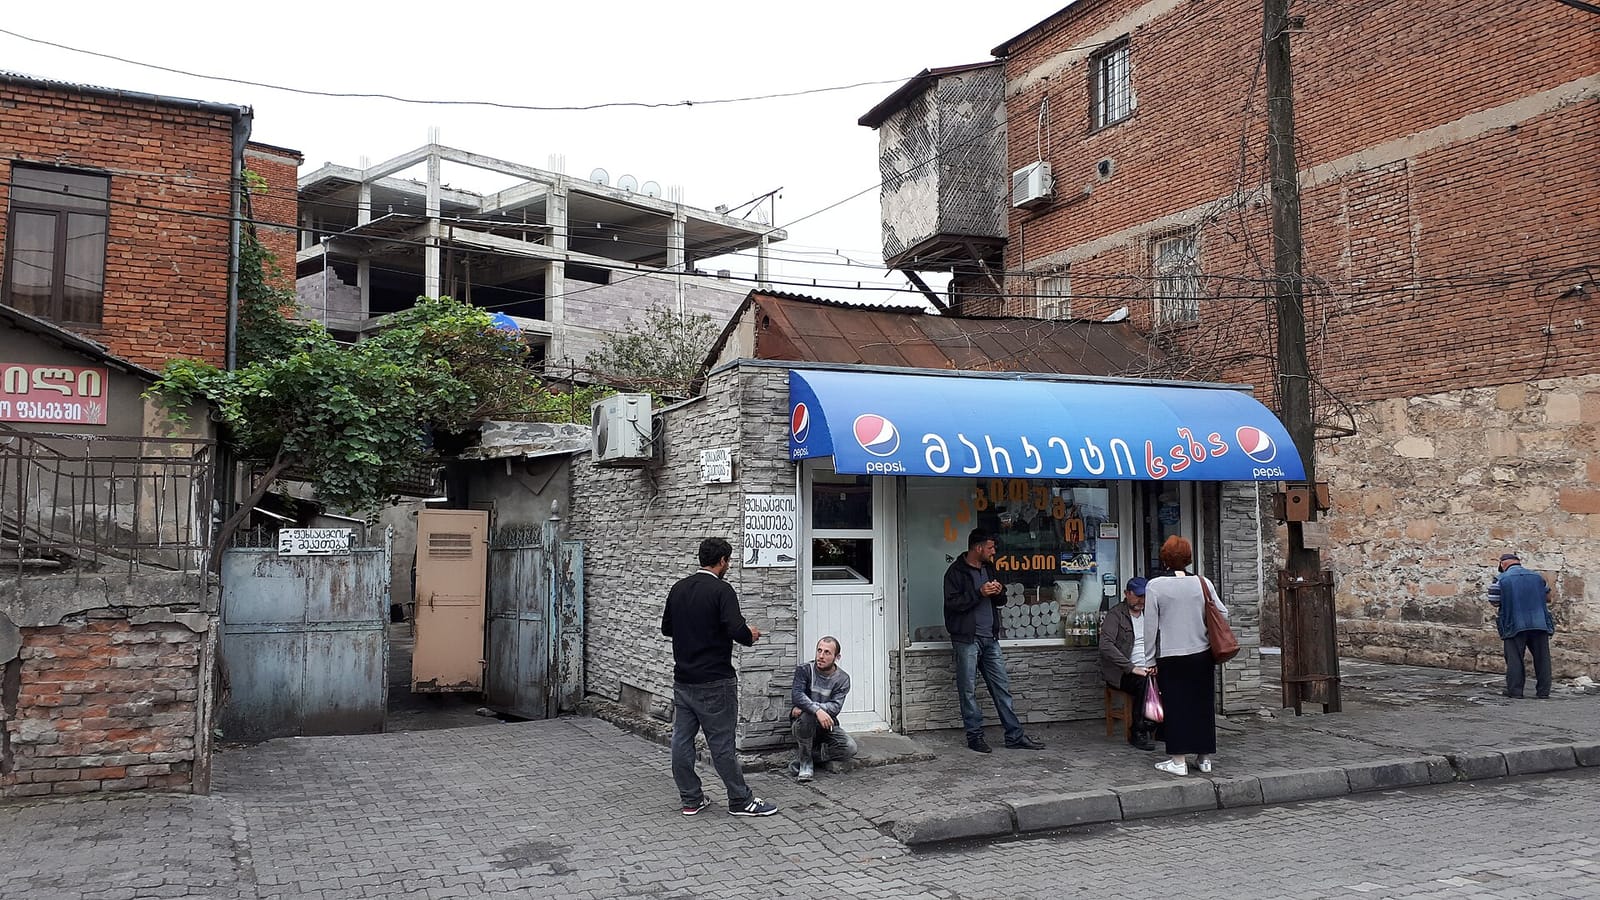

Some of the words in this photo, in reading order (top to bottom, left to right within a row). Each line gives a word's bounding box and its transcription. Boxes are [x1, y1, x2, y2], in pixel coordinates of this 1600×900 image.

[0, 366, 101, 397] ილი
[16, 401, 81, 420] ფასებში
[793, 445, 809, 457] pepsi
[922, 433, 1137, 475] მარკეტი
[1145, 427, 1229, 480] საბა
[866, 461, 904, 474] pepsi
[1252, 466, 1283, 479] pepsi
[745, 498, 795, 513] ფეხსაცმლის
[745, 515, 794, 531] შეკეთება
[990, 554, 1056, 572] რსათი
